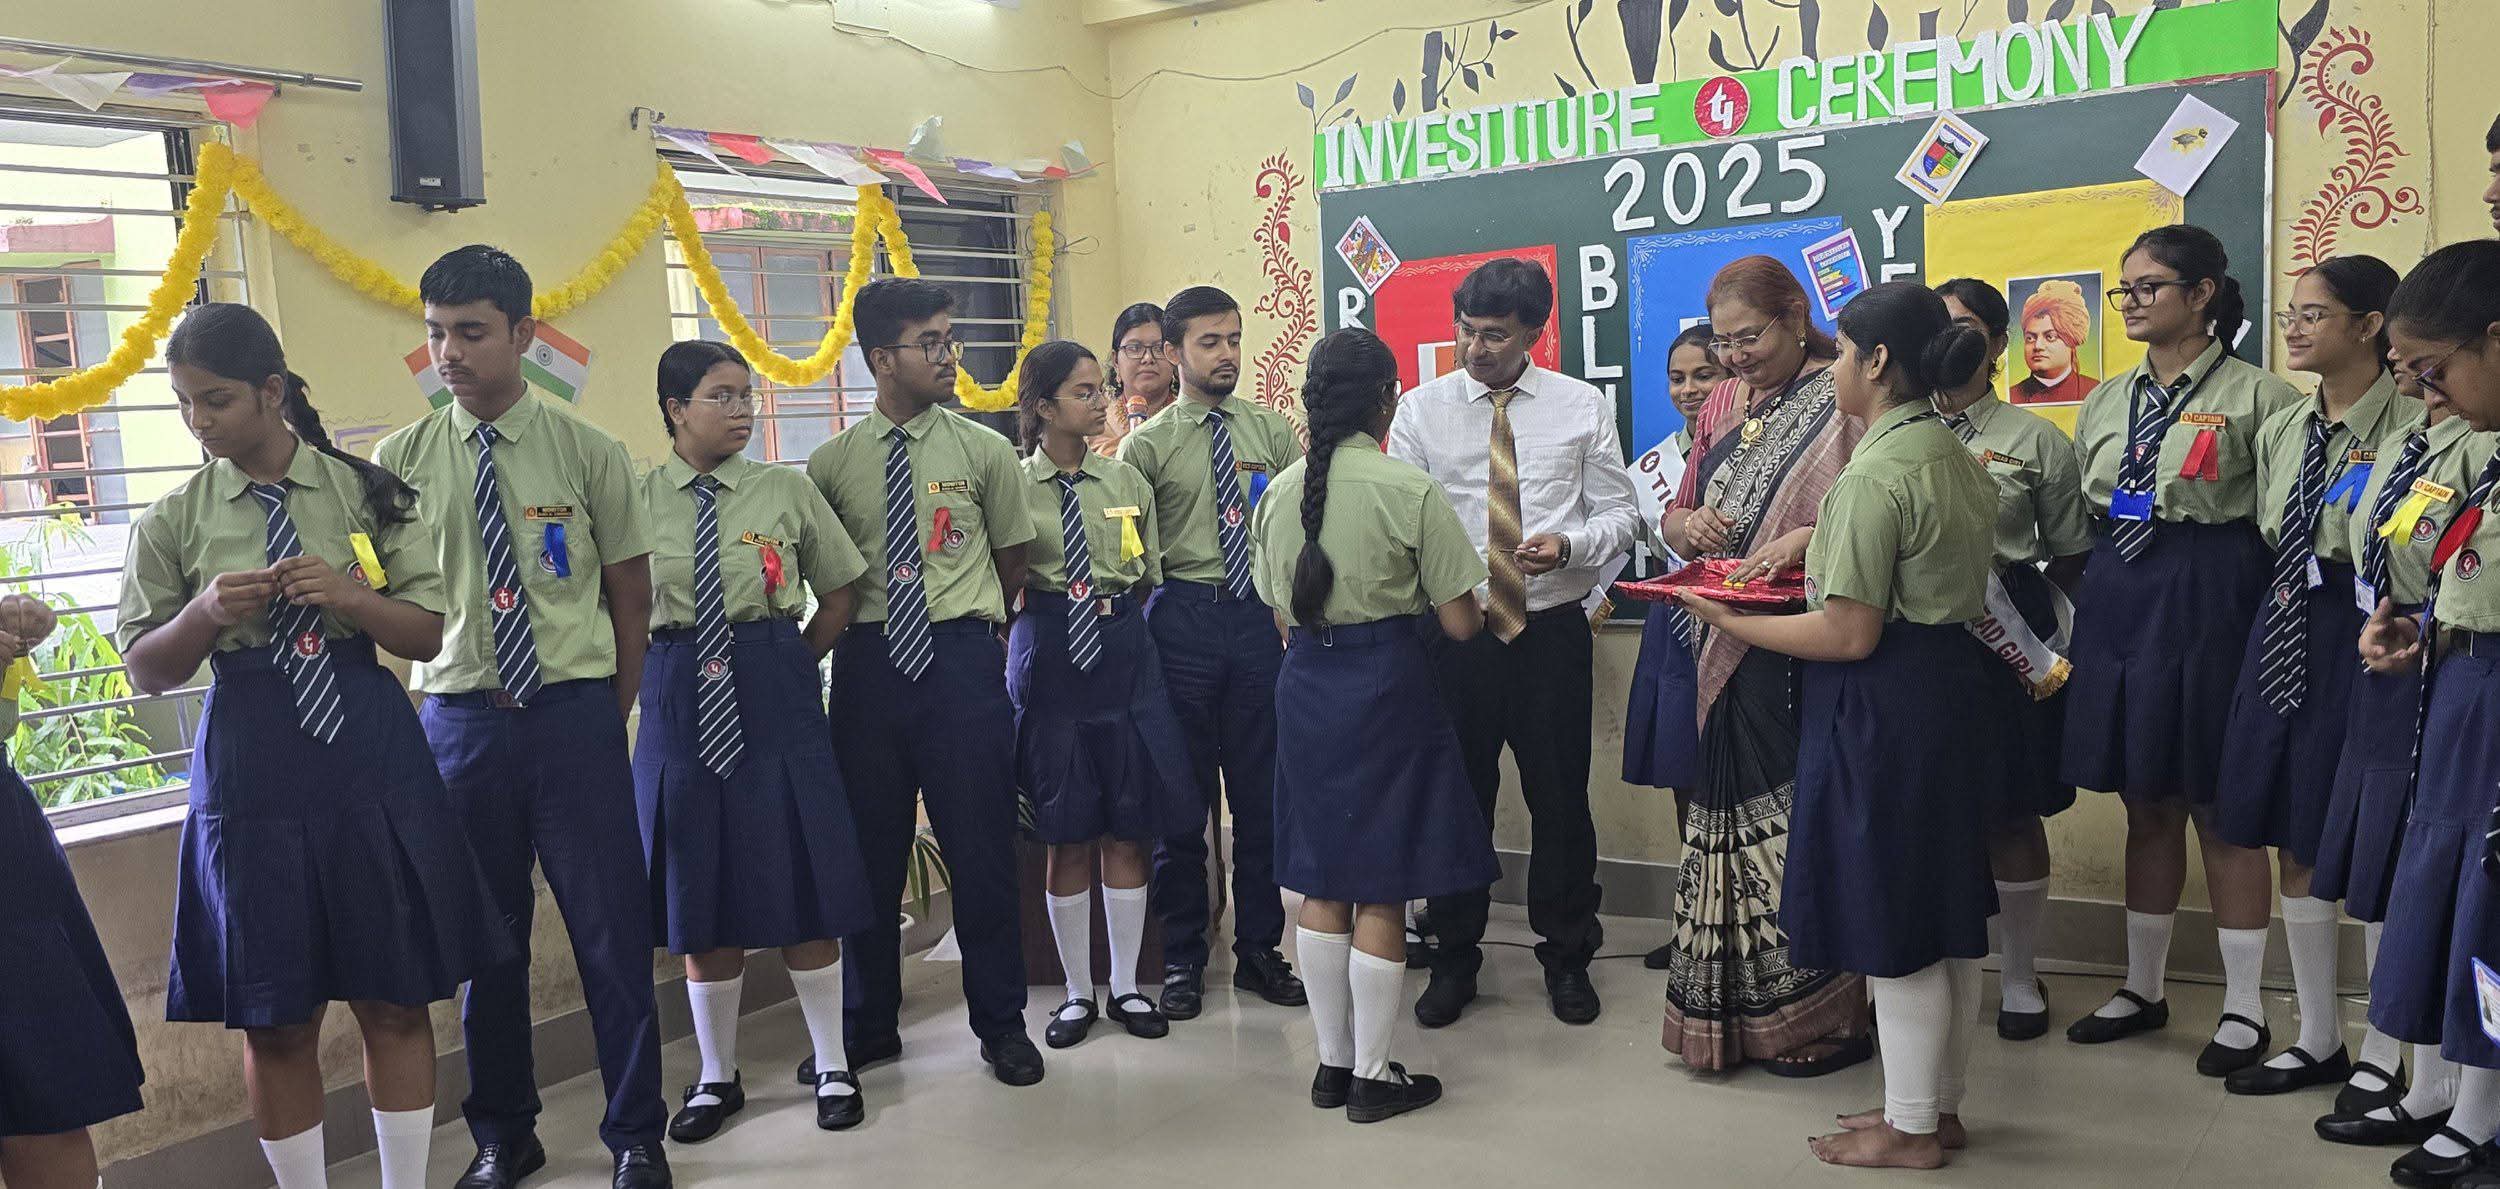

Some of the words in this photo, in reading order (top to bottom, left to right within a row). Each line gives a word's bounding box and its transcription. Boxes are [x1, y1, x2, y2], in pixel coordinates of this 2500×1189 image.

[1322, 84, 1661, 187] INVESTITURE
[1777, 5, 2157, 129] CEREMONY
[1604, 135, 1827, 232] 2025
[2194, 413, 2222, 423] CAPTAIN
